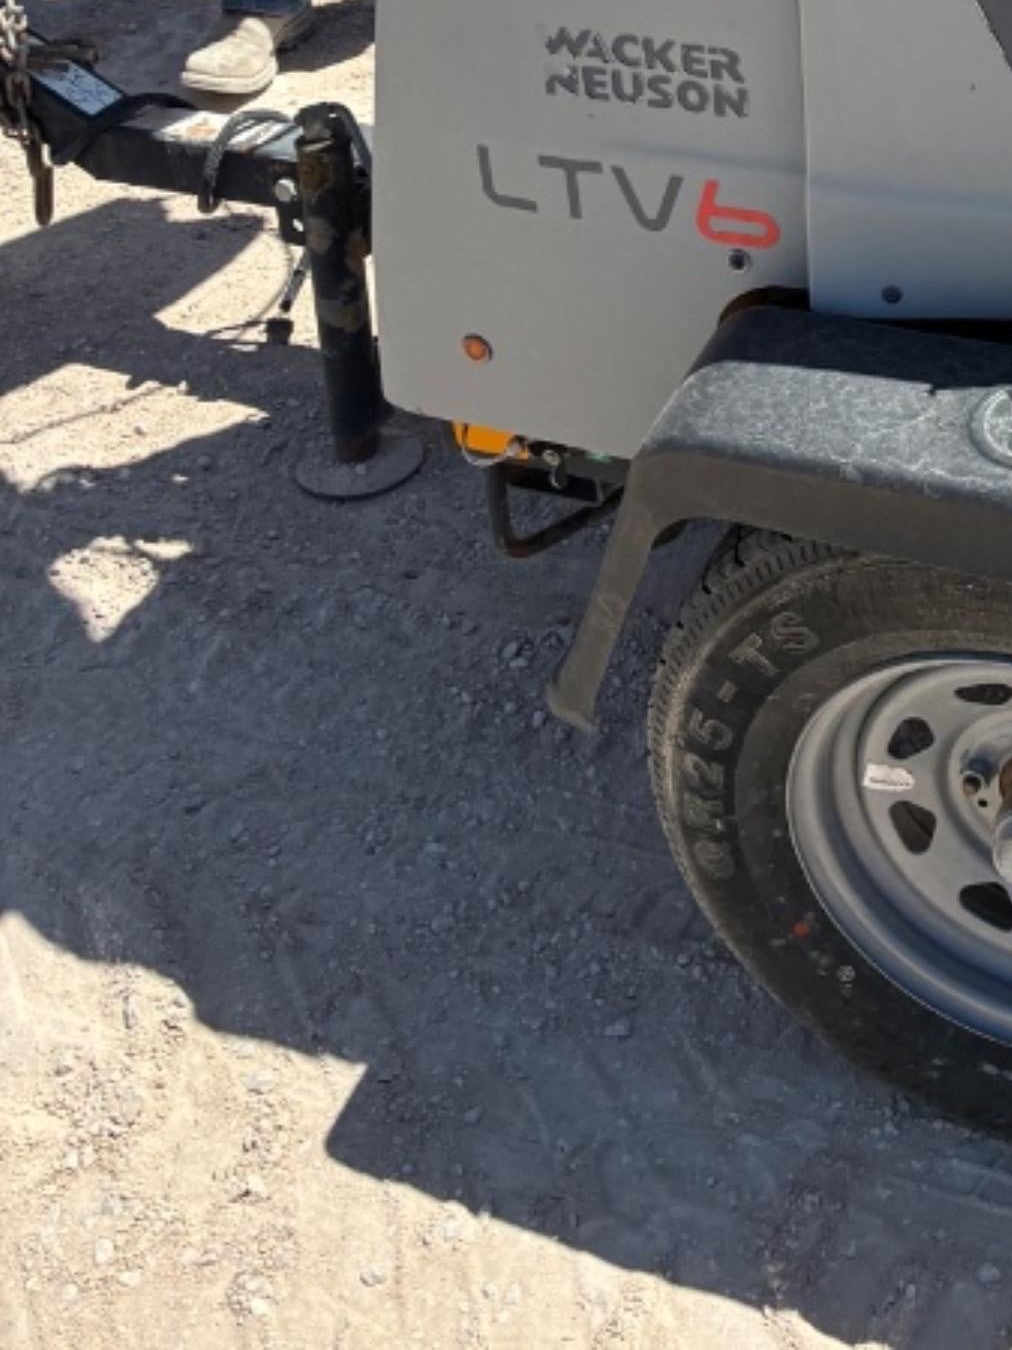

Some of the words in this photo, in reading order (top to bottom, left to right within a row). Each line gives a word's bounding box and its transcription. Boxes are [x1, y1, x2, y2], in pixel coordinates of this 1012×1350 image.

[544, 26, 745, 84] WACKER
[545, 64, 748, 118] NEUSON
[476, 143, 781, 250] LTV6
